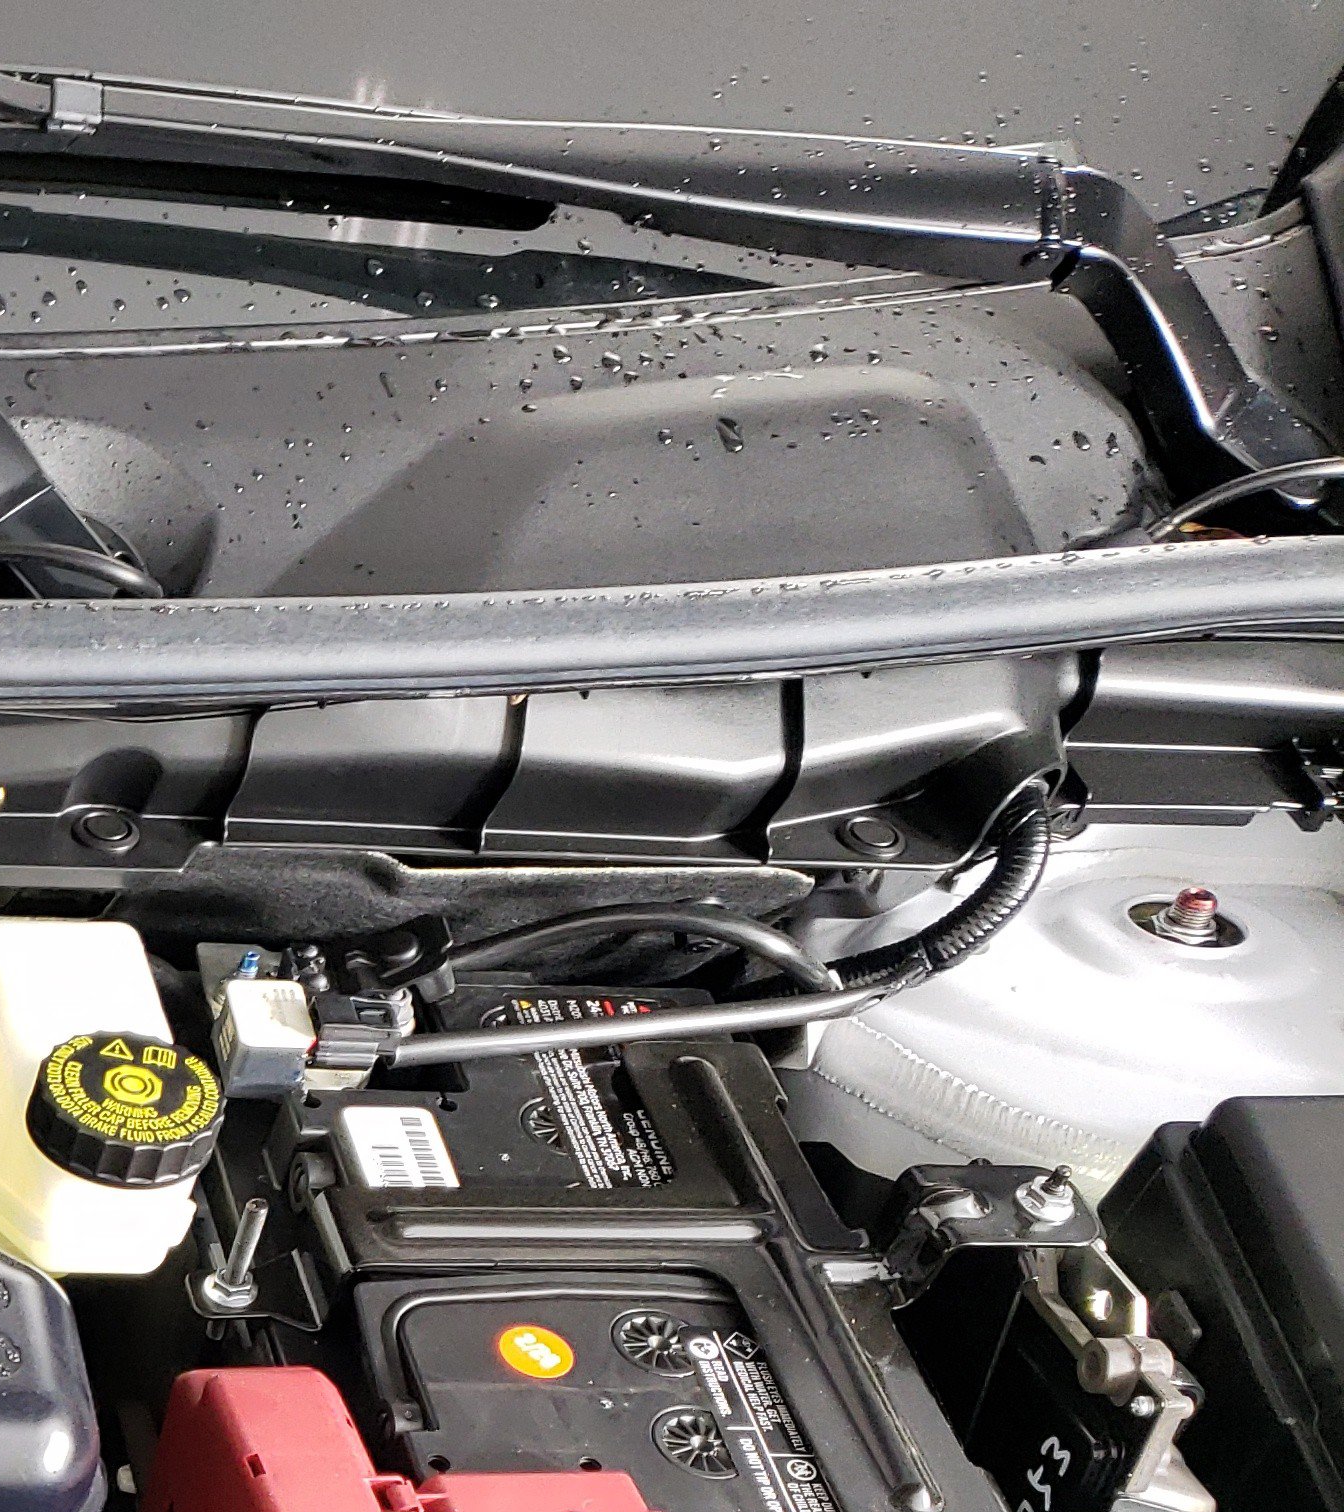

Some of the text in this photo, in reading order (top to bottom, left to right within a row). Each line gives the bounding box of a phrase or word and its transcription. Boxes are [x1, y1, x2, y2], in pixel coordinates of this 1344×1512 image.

[68, 1087, 102, 1116] FILLER
[98, 1110, 126, 1126] CAP
[126, 1115, 175, 1131] BEFORE
[170, 1085, 202, 1124] REMOVING
[101, 1098, 159, 1119] WARNING
[585, 1085, 602, 1110] Motors
[596, 1111, 612, 1132] North
[79, 1113, 118, 1136] BRAKE
[119, 1127, 155, 1143] FLUID
[155, 1125, 190, 1142] FROM
[623, 1113, 639, 1136] Group
[711, 1361, 728, 1381] READ
[733, 1361, 773, 1432] MEDICAL HELP FAST.
[745, 1362, 761, 1380] WITH
[766, 1409, 781, 1422] GET
[757, 1362, 806, 1451] FLUSH EYES IMMEDIATELY
[740, 1439, 755, 1451] DO
[745, 1453, 764, 1470] NOT
[754, 1471, 770, 1485] TIP
[788, 1483, 800, 1493] OF
[761, 1487, 776, 1499] OR
[800, 1483, 814, 1496] THE
[812, 1484, 829, 1501] KEEP
